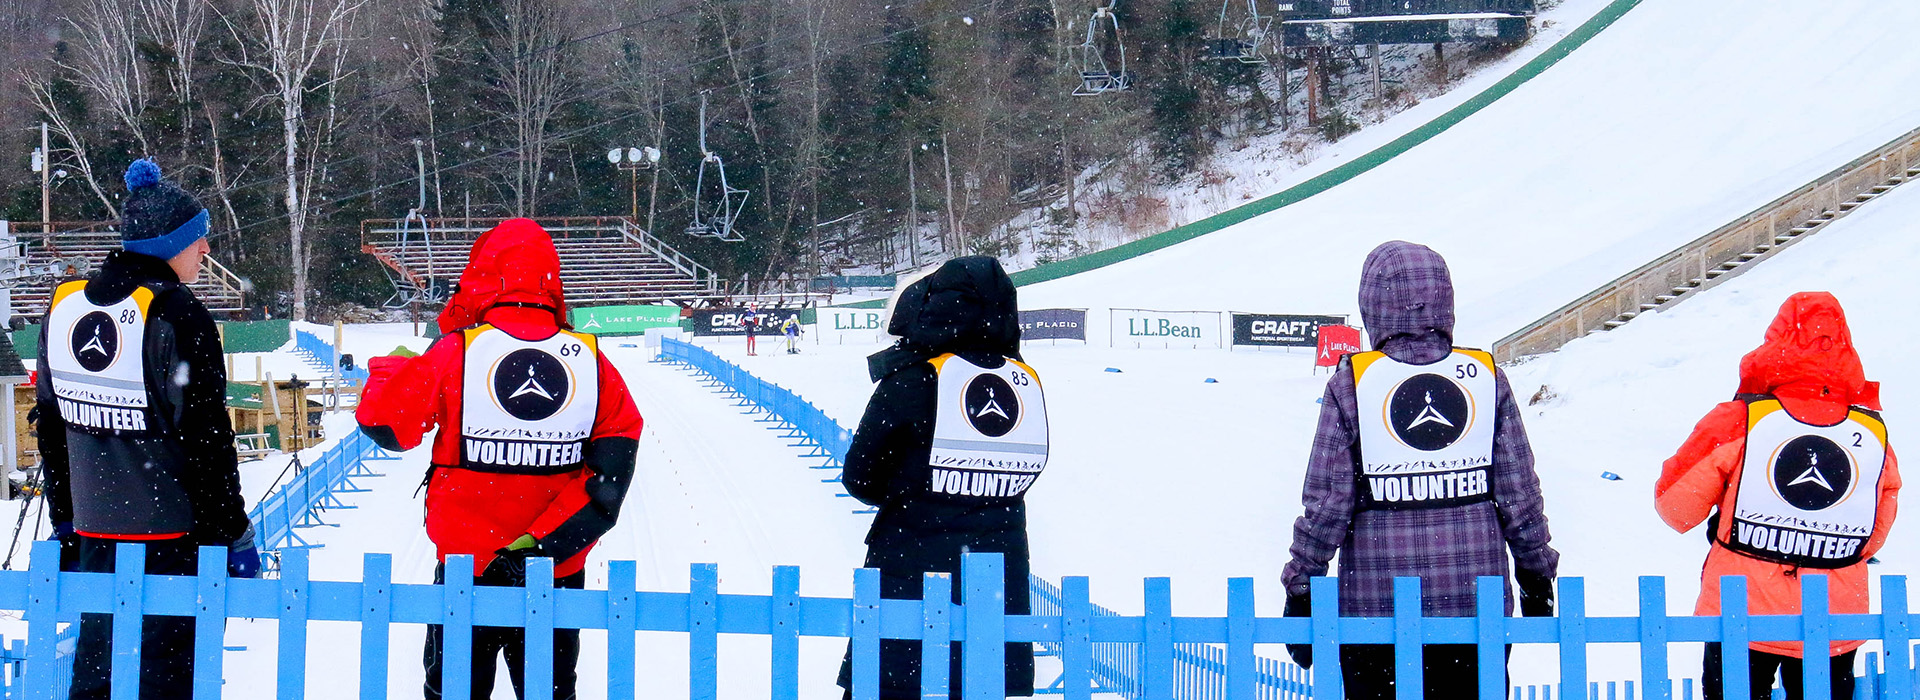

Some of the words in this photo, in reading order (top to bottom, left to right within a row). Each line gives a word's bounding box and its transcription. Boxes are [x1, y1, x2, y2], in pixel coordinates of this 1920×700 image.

[1278, 3, 1294, 11] RANK
[1331, 6, 1352, 14] POINTS
[1404, 1, 1410, 9] 6
[120, 309, 136, 325] 88
[711, 313, 768, 327] CRAT
[834, 313, 886, 330] L.L.B
[1129, 318, 1201, 338] L.L.Bean
[1251, 320, 1311, 335] CRAFT
[560, 343, 581, 357] 69
[1011, 370, 1029, 386] 85
[1455, 363, 1478, 379] 50
[1852, 432, 1863, 448] 2
[466, 439, 583, 467] VOLUNTEER
[1369, 469, 1488, 502] VOLUNTEER
[1738, 521, 1862, 559] VOLUNTEER
